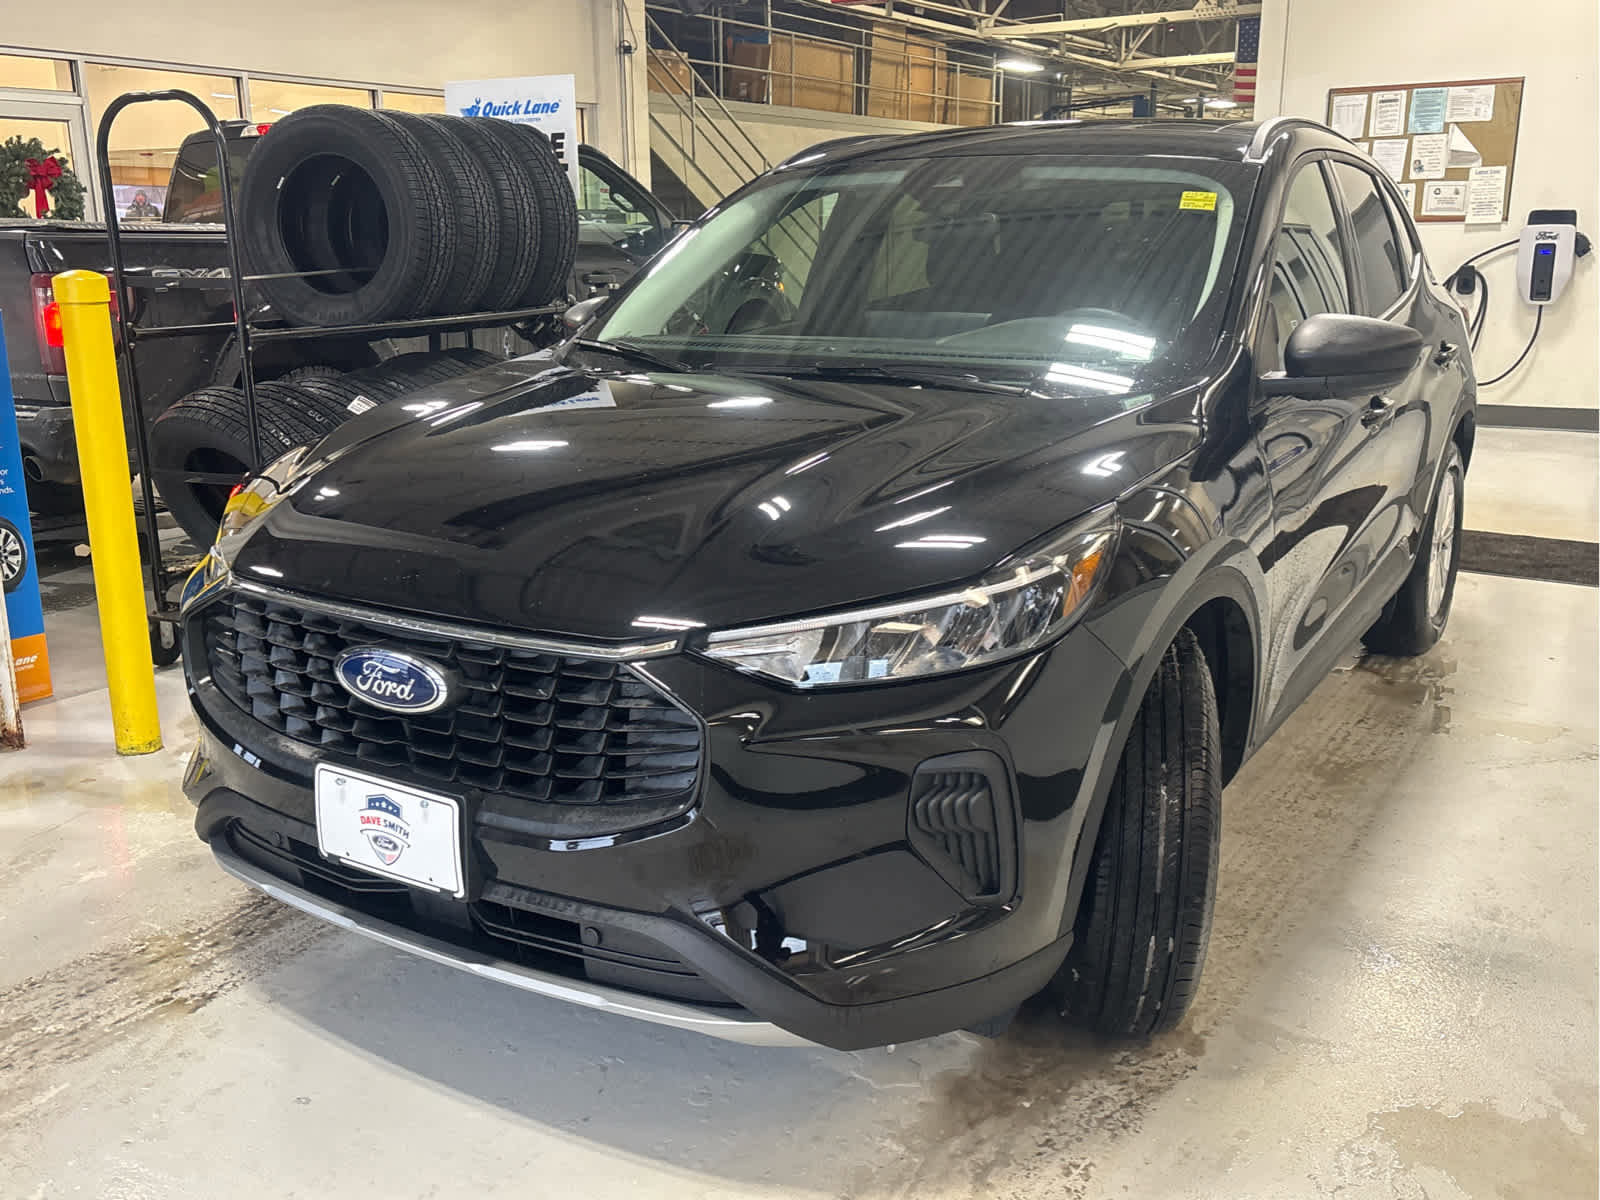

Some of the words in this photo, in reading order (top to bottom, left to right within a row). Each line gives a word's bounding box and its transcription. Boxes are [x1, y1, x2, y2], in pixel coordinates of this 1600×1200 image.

[482, 101, 521, 118] Quick
[524, 100, 559, 114] Lane
[1535, 231, 1560, 240] Ford
[15, 655, 38, 666] ane
[356, 661, 415, 701] Ford
[360, 815, 382, 827] DAVE
[383, 818, 410, 839] SMITH
